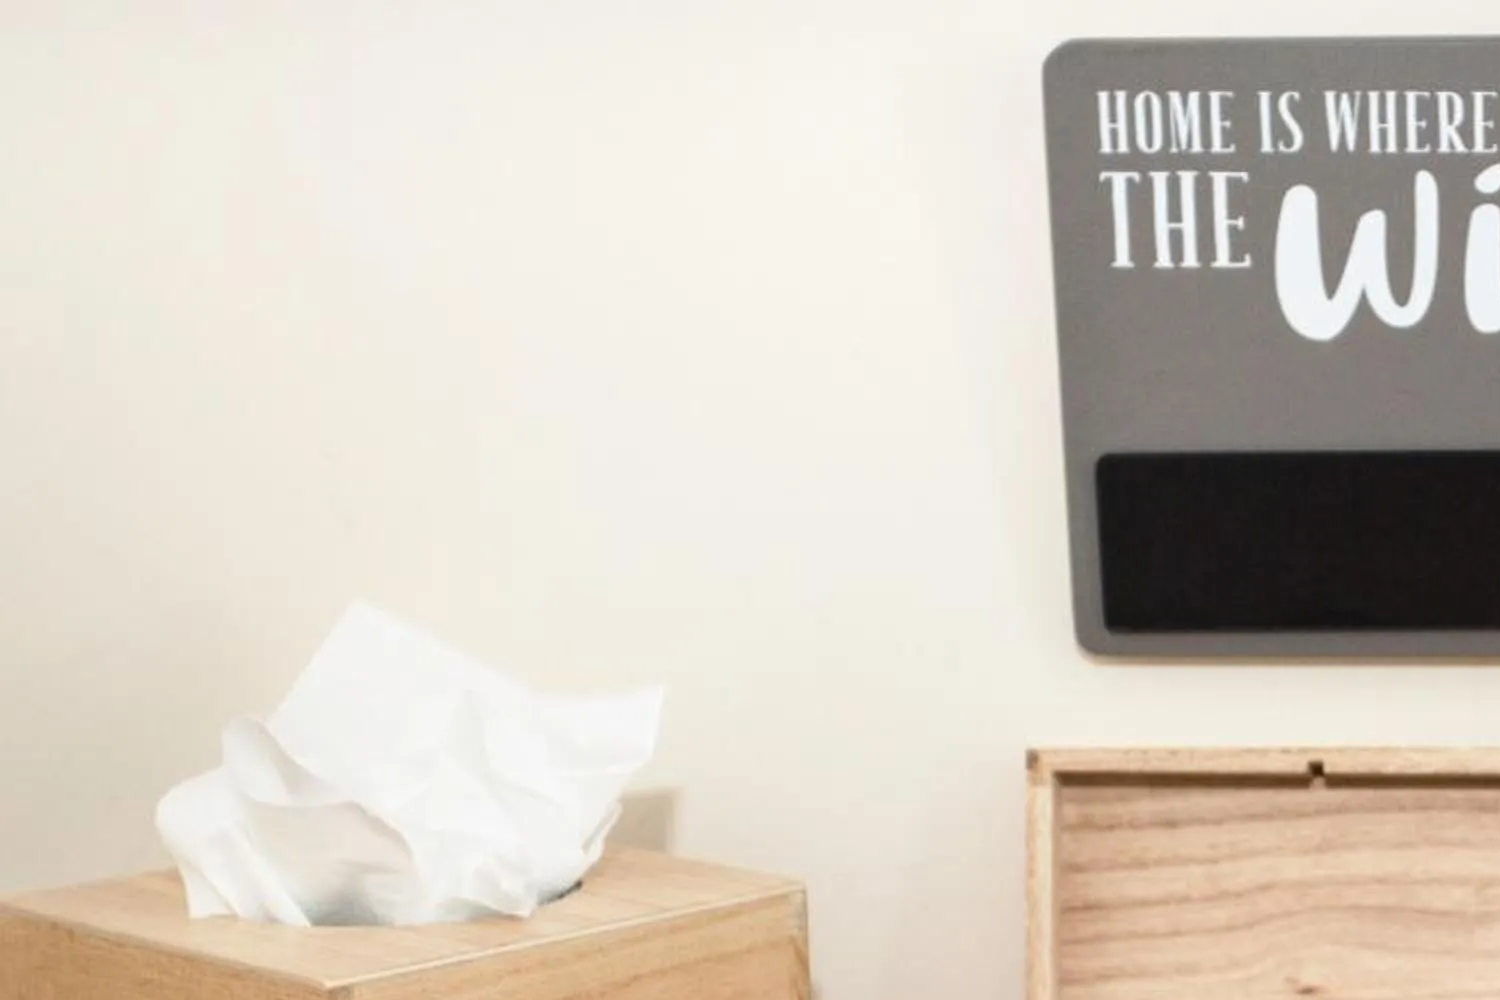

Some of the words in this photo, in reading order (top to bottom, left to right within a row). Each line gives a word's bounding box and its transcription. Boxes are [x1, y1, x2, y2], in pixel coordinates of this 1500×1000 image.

[1098, 91, 1234, 153] HOME
[1259, 92, 1303, 152] IS
[1325, 91, 1497, 152] WHERE
[1100, 171, 1251, 268] THE
